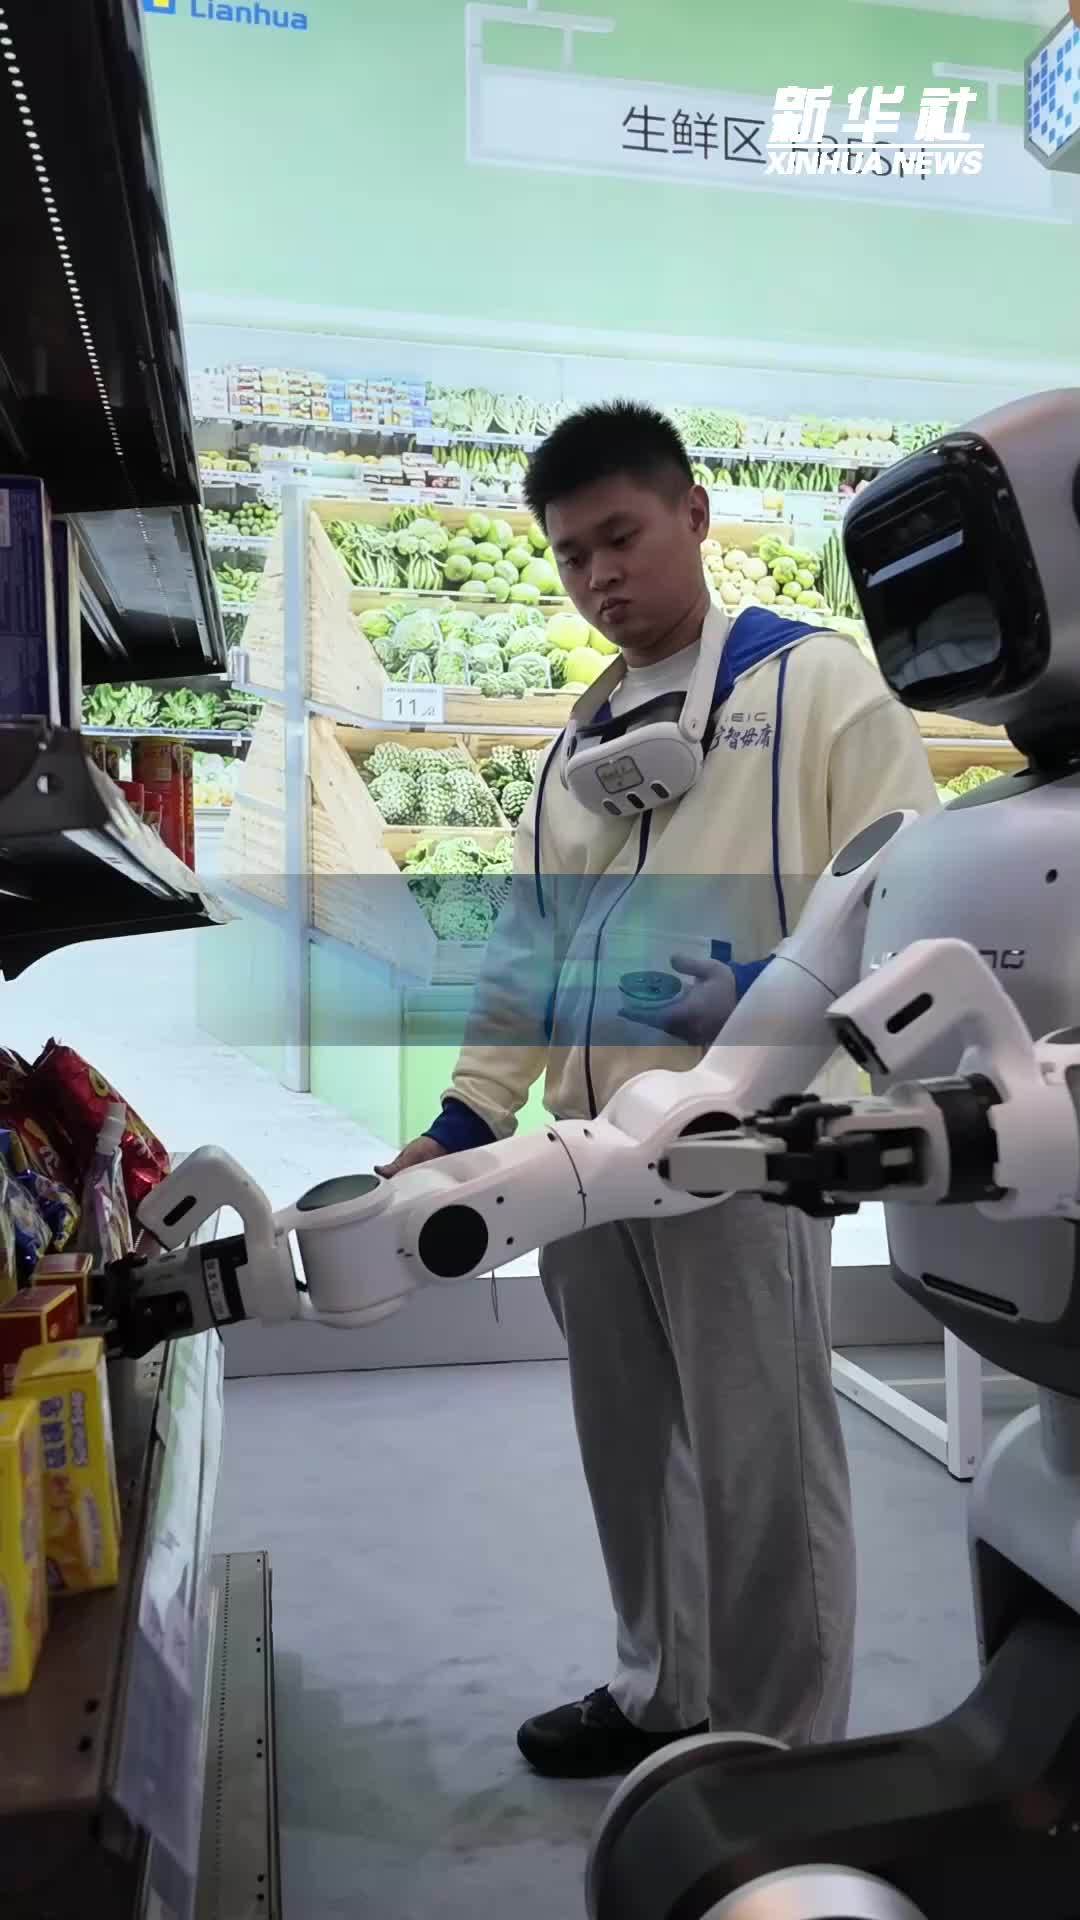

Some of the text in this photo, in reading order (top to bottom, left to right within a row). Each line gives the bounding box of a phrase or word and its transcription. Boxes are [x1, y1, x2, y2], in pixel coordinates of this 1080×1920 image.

[190, 0, 308, 30] Lianhua
[622, 105, 767, 164] 生鲜区
